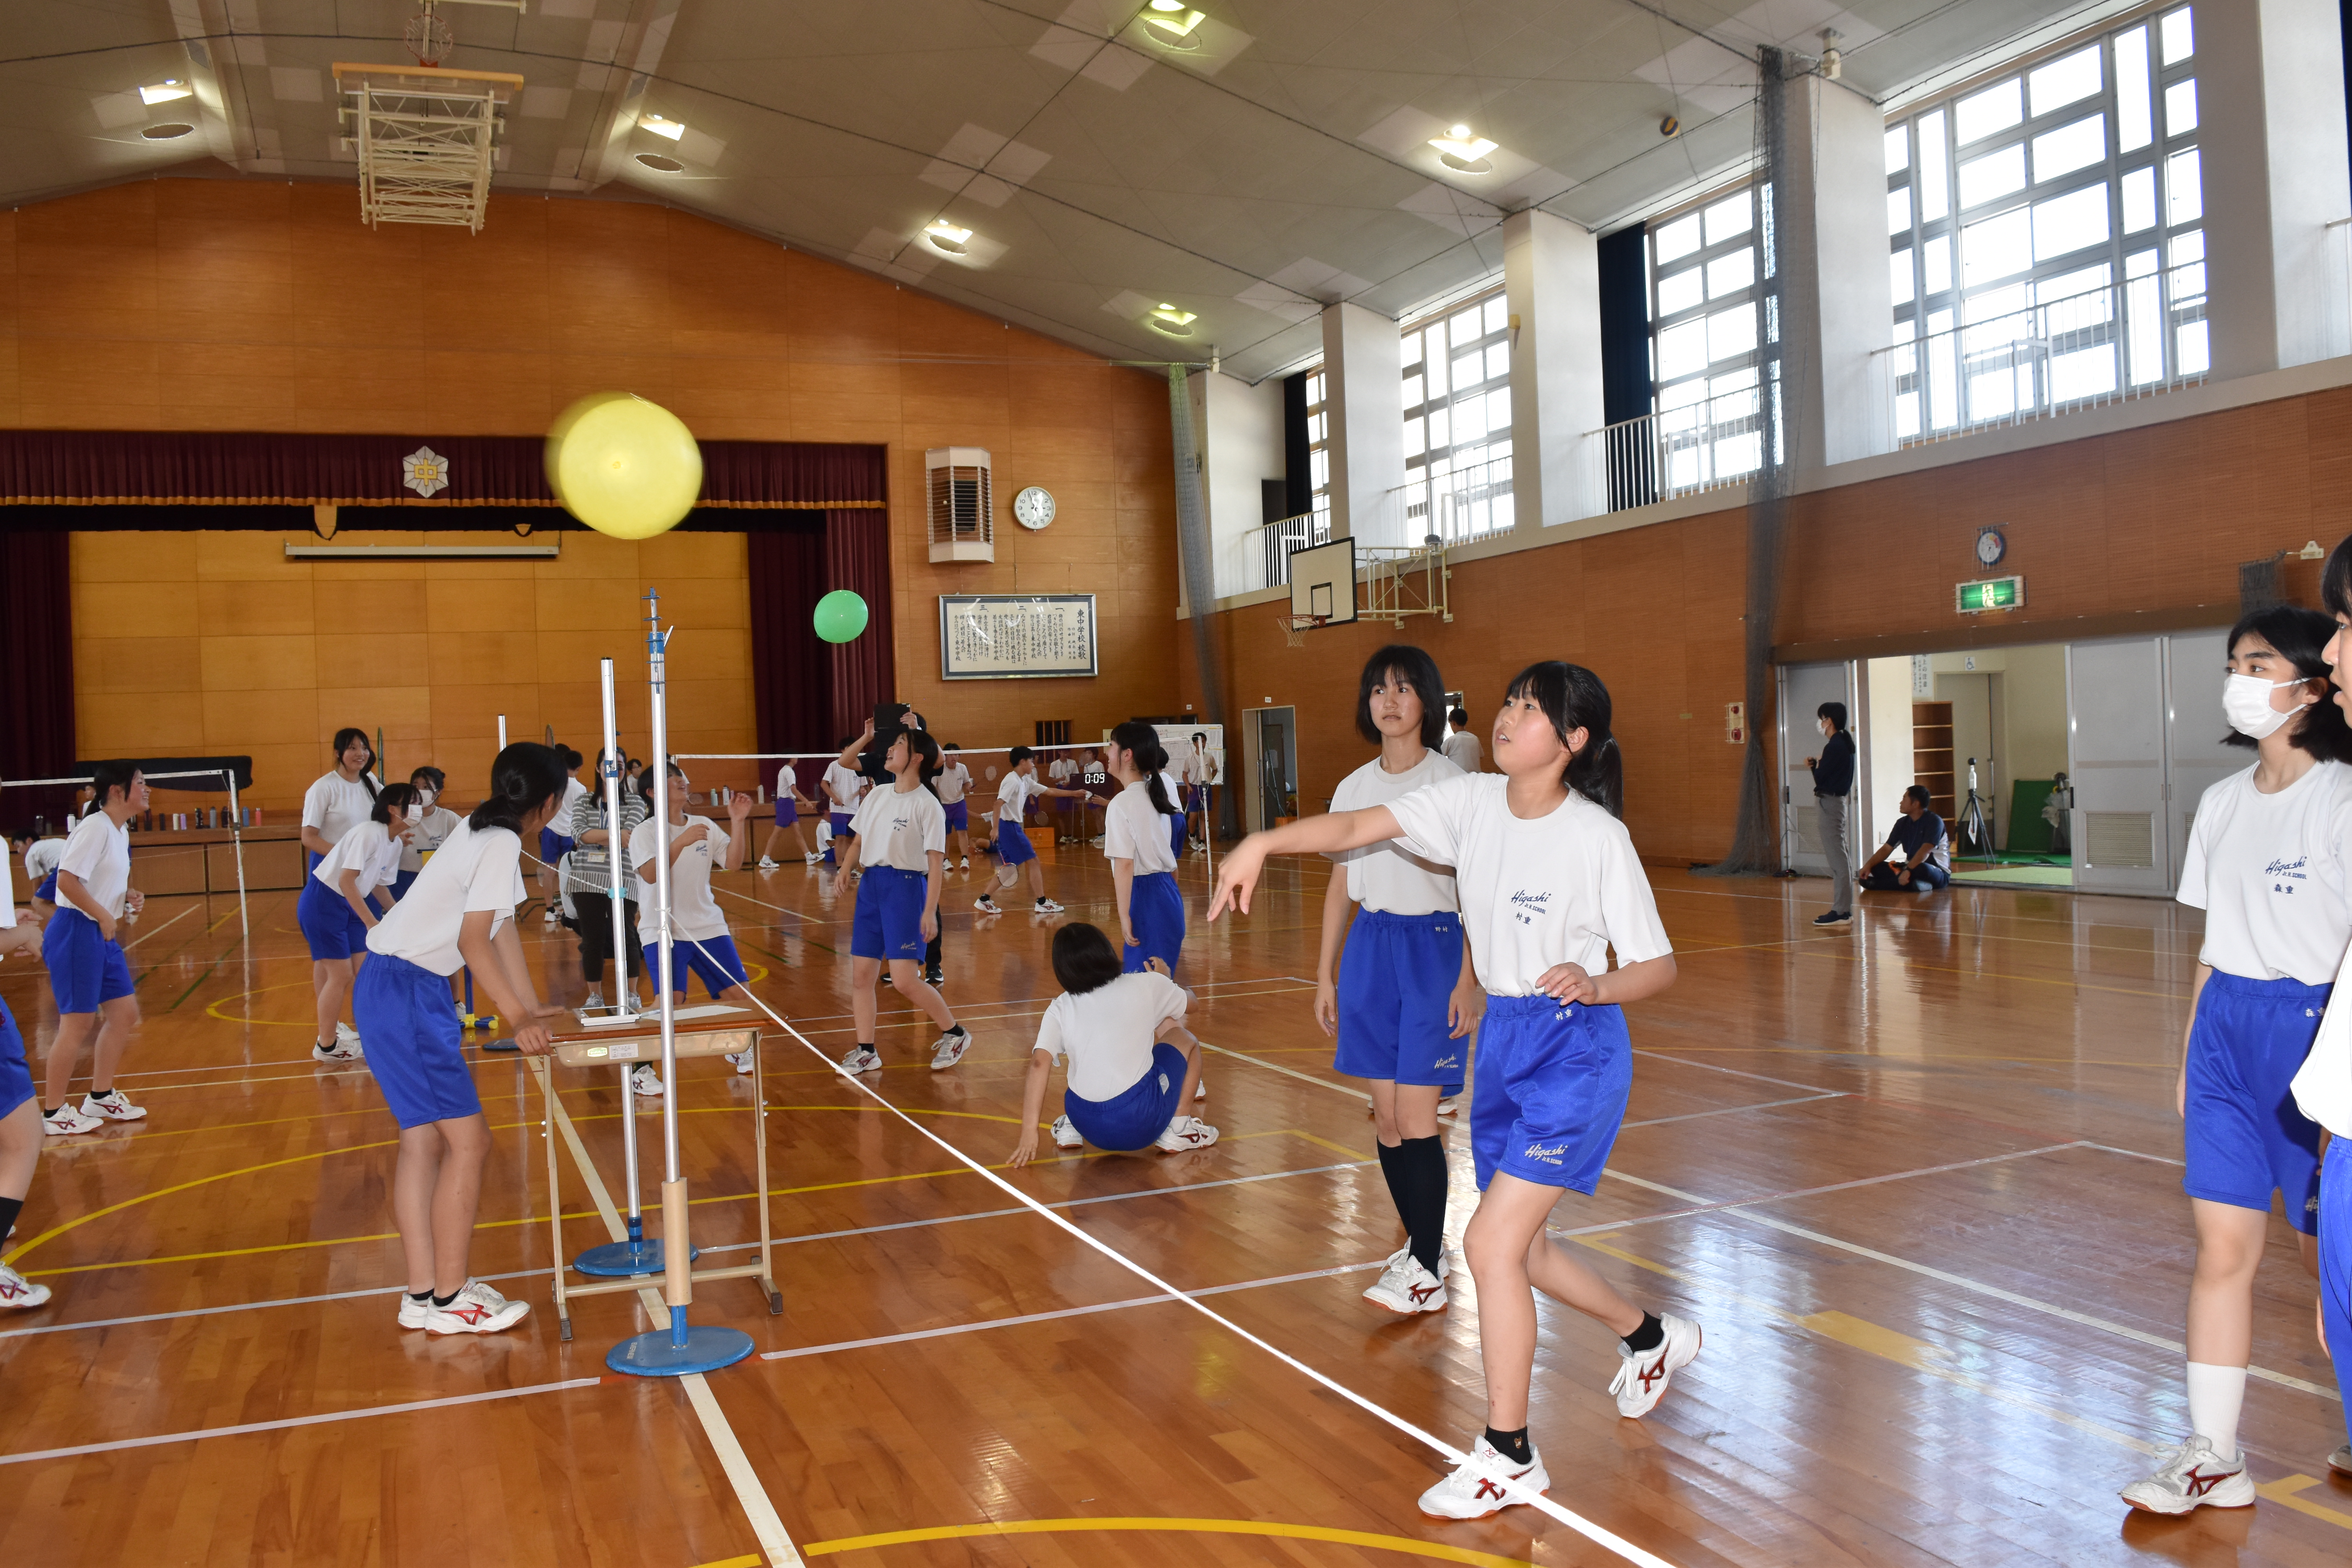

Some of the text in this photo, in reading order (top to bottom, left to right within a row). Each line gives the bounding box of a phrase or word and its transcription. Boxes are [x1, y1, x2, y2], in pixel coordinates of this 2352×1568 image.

[1077, 608, 1087, 659] 東中学校 校歌
[1085, 773, 1105, 784] 0:09
[2265, 856, 2307, 877] Higashi
[2274, 883, 2294, 894] 森重
[1511, 889, 1552, 906] Higashi
[1515, 912, 1532, 925] 村重
[1524, 1143, 1568, 1160] Higashi
